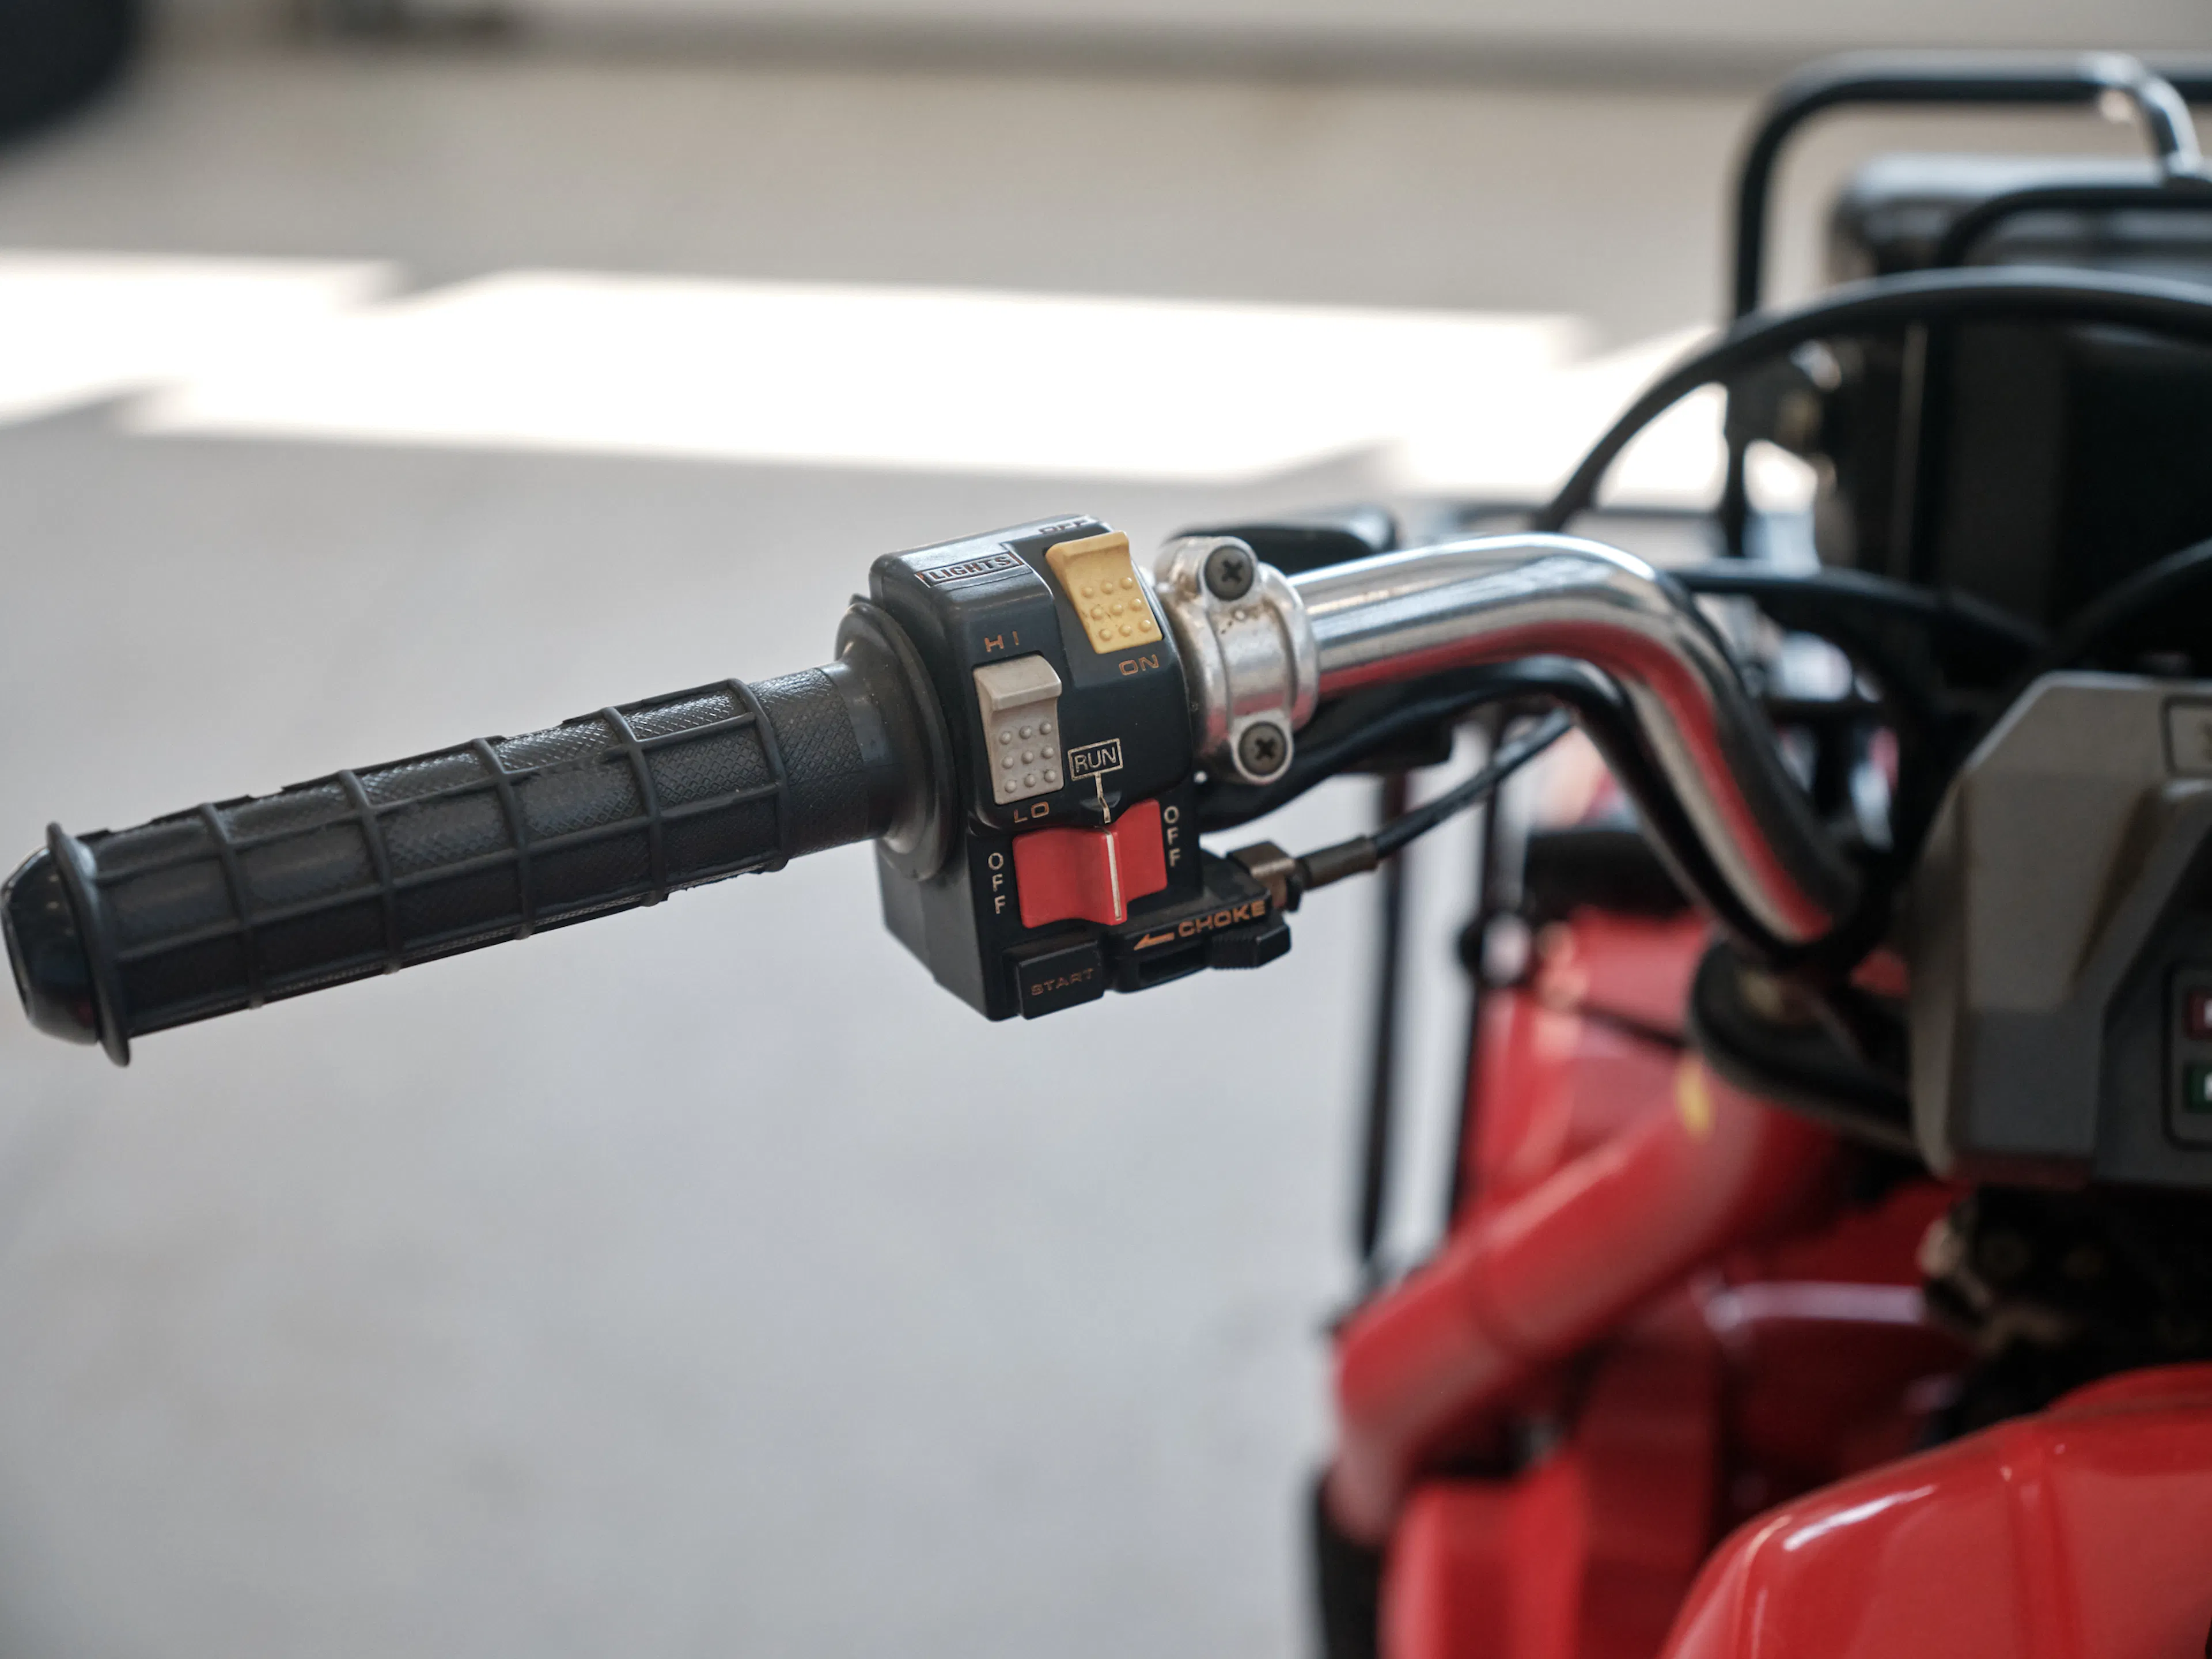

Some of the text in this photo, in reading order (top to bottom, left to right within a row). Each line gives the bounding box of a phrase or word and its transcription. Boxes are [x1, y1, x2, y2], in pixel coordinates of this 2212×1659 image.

[930, 556, 1012, 581] LIGHTS
[984, 631, 1020, 652] HI
[1119, 654, 1159, 675] ON
[1075, 748, 1116, 774] RUN
[1014, 801, 1050, 823] LO
[1164, 806, 1181, 868] OFF
[988, 853, 1006, 915] OFF
[1179, 900, 1266, 938] CHOKE
[1031, 968, 1094, 995] START
